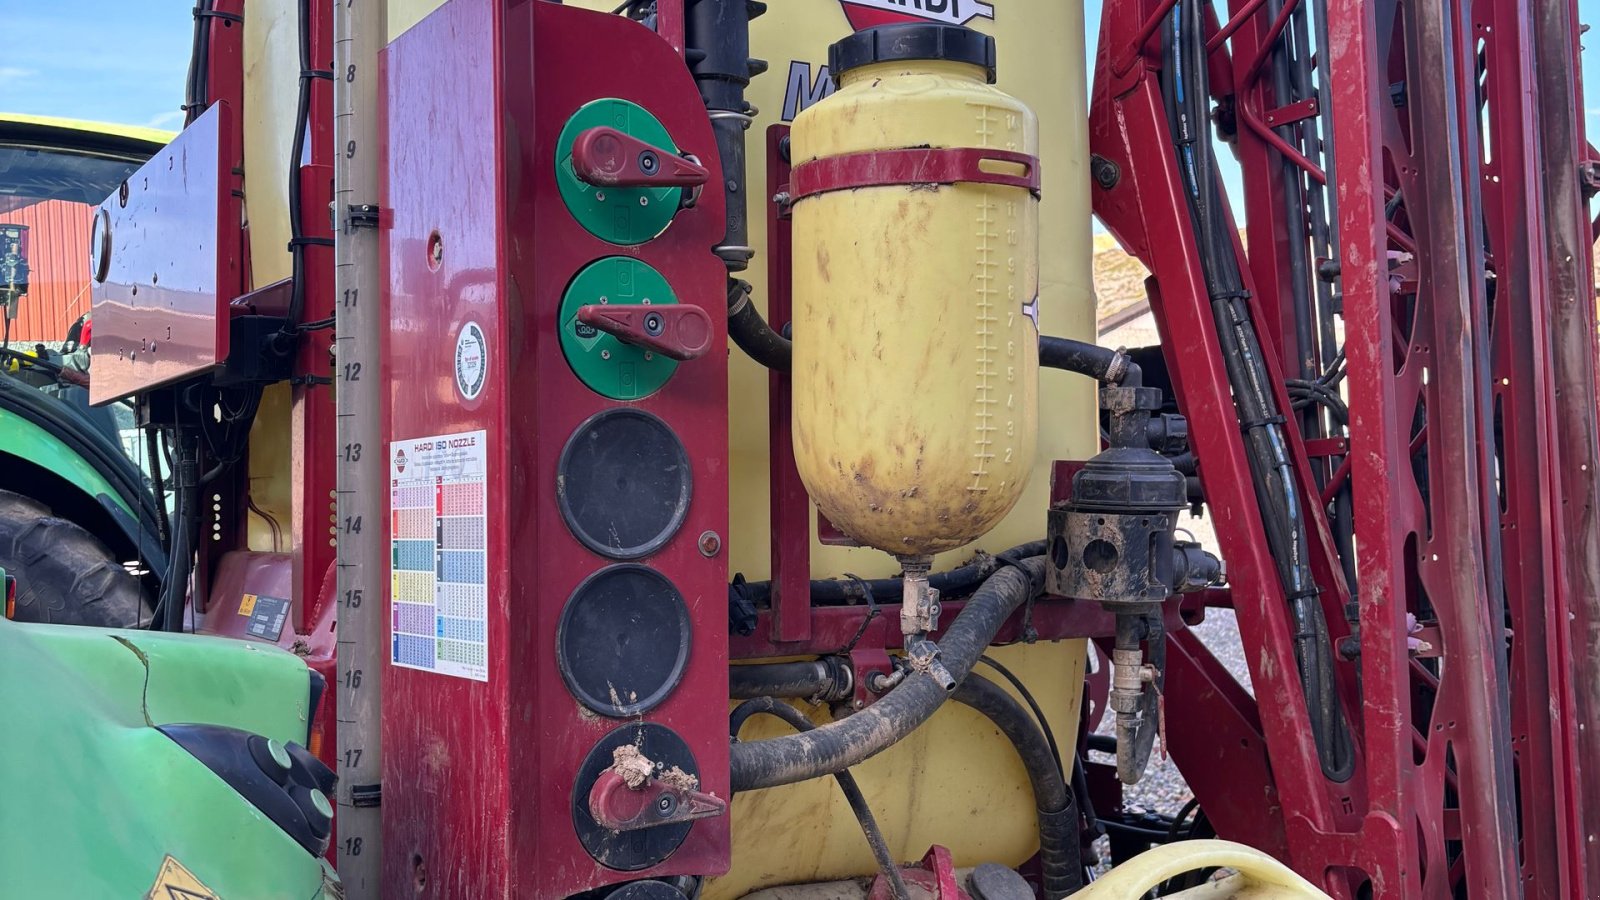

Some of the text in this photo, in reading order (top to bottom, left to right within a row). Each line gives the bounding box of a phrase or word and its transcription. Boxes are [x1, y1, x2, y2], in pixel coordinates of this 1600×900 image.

[346, 64, 356, 83] 8
[346, 140, 356, 159] 9
[1006, 202, 1016, 216] 11
[1006, 229, 1017, 245] 10
[1008, 257, 1015, 272] 9
[343, 288, 359, 307] 11
[1007, 312, 1014, 328] 7
[344, 362, 361, 381] 12
[1007, 367, 1014, 382] 5
[1007, 421, 1014, 436] 3
[344, 443, 362, 462] 13
[414, 437, 475, 452] HARDI ISO NOZZLE
[1004, 448, 1012, 463] 2
[345, 516, 362, 535] 14
[345, 589, 362, 609] 15
[345, 669, 362, 689] 16
[345, 749, 362, 768] 17
[345, 836, 362, 856] 18
